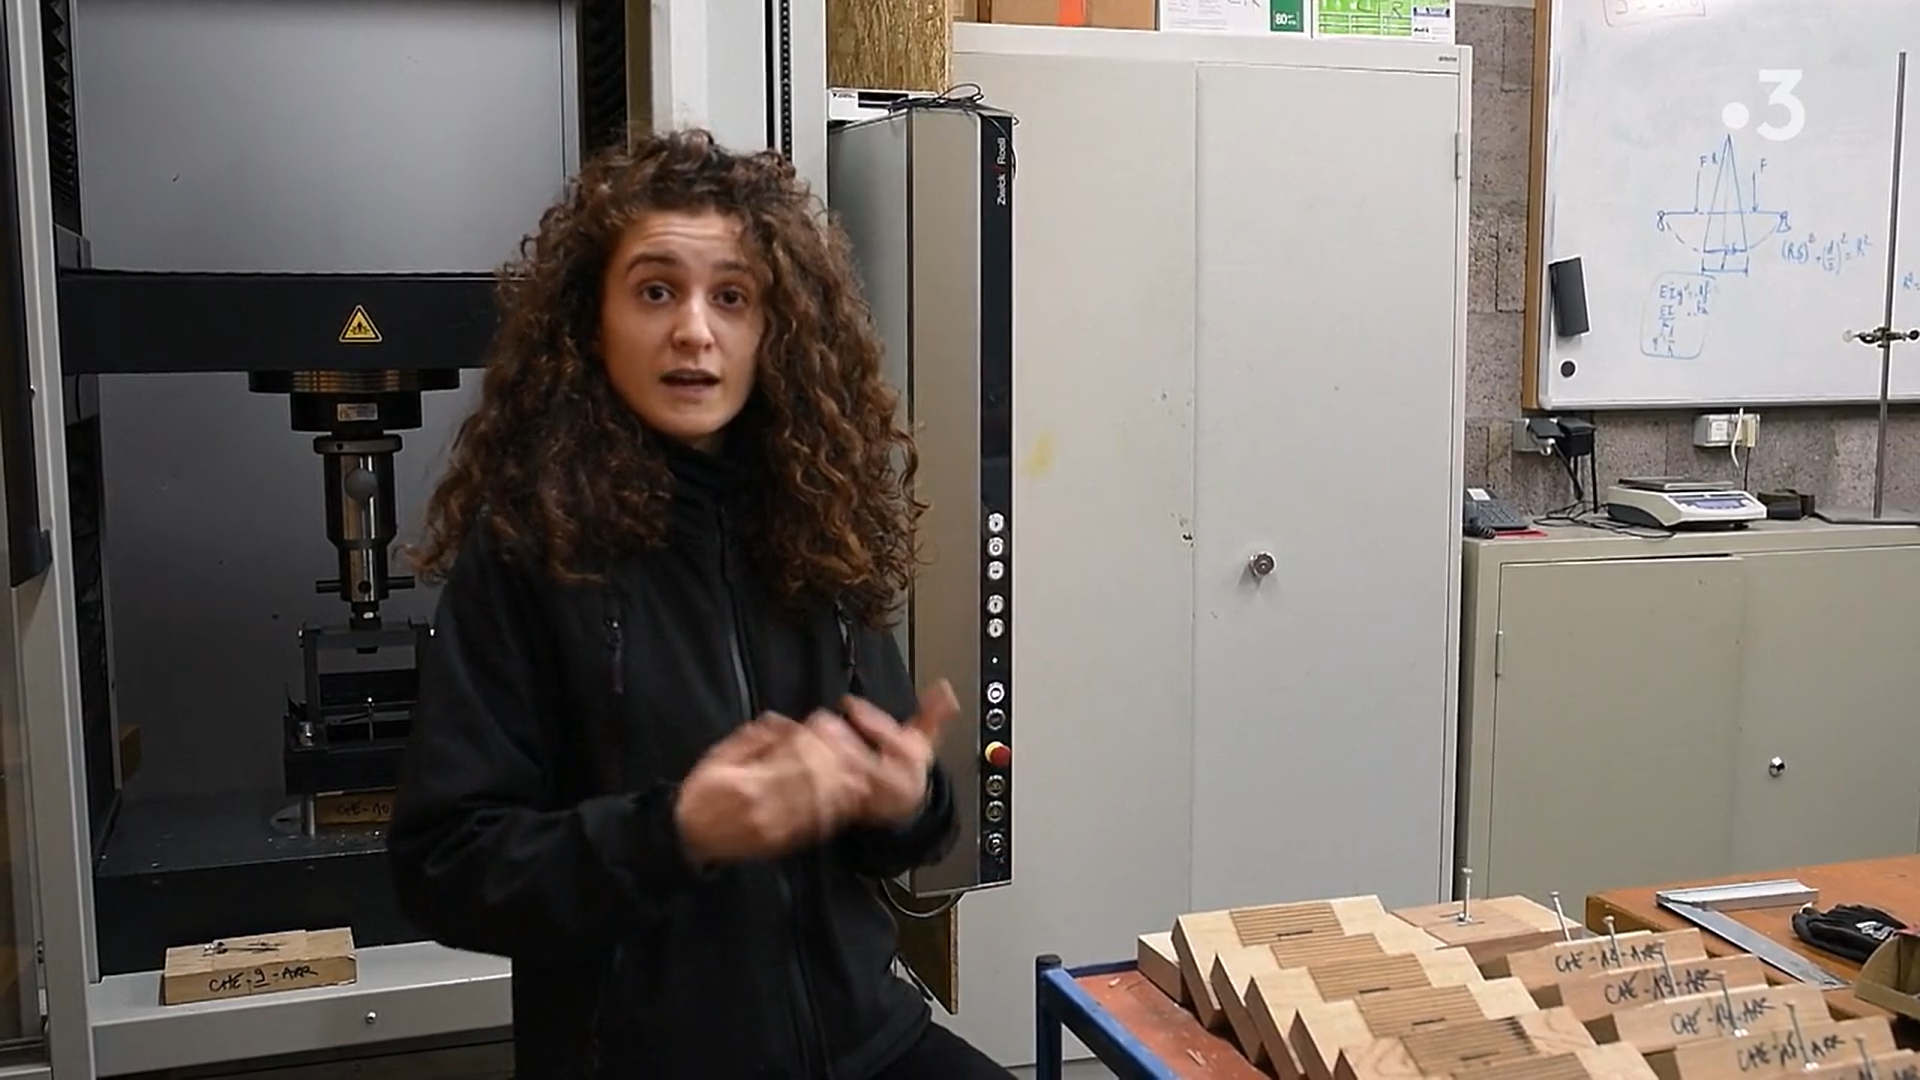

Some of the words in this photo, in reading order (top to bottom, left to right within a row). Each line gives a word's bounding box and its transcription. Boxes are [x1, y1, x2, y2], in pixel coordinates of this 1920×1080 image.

[1275, 13, 1288, 25] 80
[997, 137, 1006, 165] Roell
[997, 175, 1006, 206] Zwick
